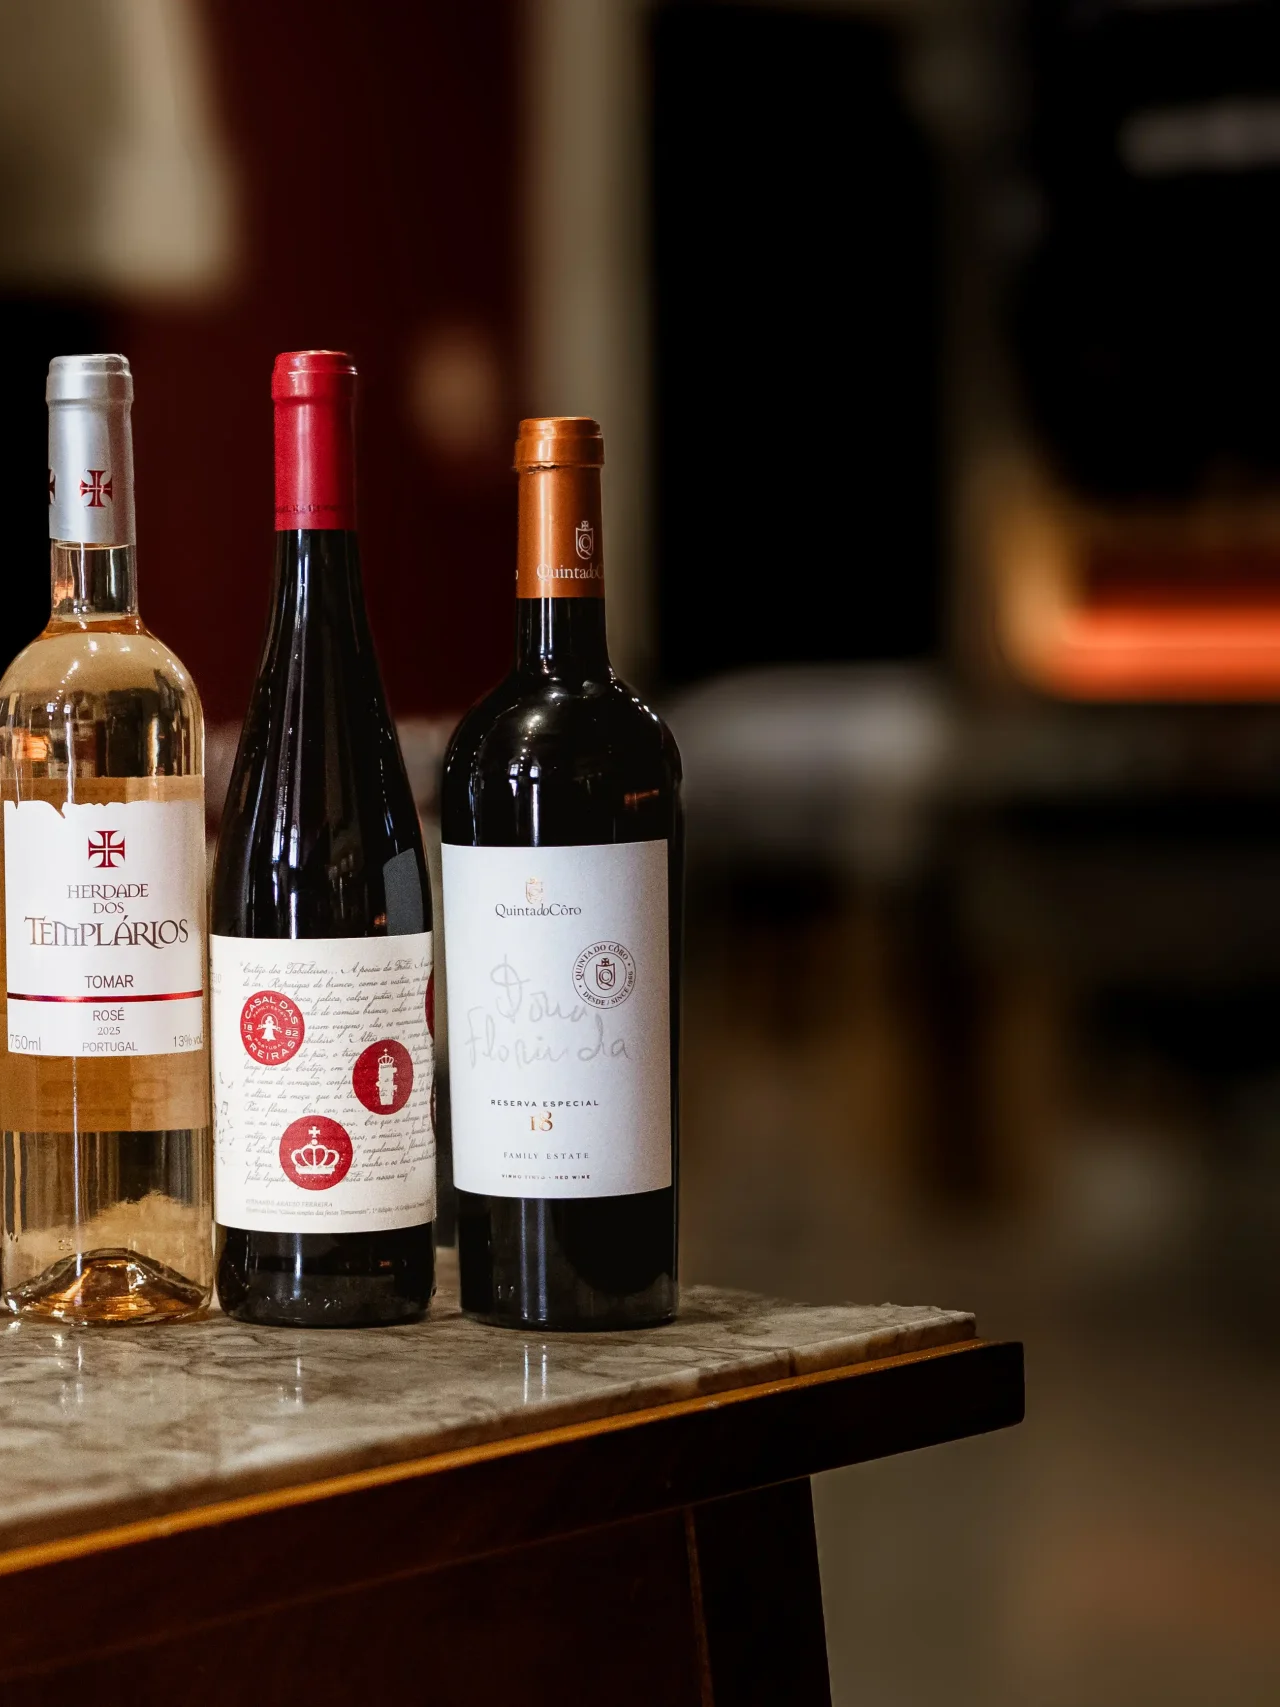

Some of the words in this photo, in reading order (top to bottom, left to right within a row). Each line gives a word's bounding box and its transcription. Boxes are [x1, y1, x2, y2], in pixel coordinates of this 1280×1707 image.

[66, 883, 149, 900] HERDADE
[92, 901, 125, 914] DOS
[24, 914, 189, 950] TEMPLÁRIOS
[575, 950, 593, 981] QUINTA
[593, 944, 606, 953] DO
[608, 944, 629, 960] CÔRO
[84, 974, 134, 989] TOMAR
[582, 991, 606, 1006] DESDE
[611, 987, 629, 1005] SINCE
[92, 1007, 125, 1022] ROSÉ
[245, 996, 276, 1020] CASAL
[279, 1000, 298, 1024] DAS
[173, 1033, 192, 1048] 13%
[285, 1029, 299, 1037] 82
[9, 1033, 42, 1051] 750ml
[82, 1041, 138, 1052] PORTUGAL
[490, 1099, 537, 1107] RESERVA
[542, 1100, 599, 1108] ESPECIAL
[529, 1110, 553, 1132] 18
[503, 1151, 539, 1159] FAMILY
[546, 1152, 590, 1160] ESTATE
